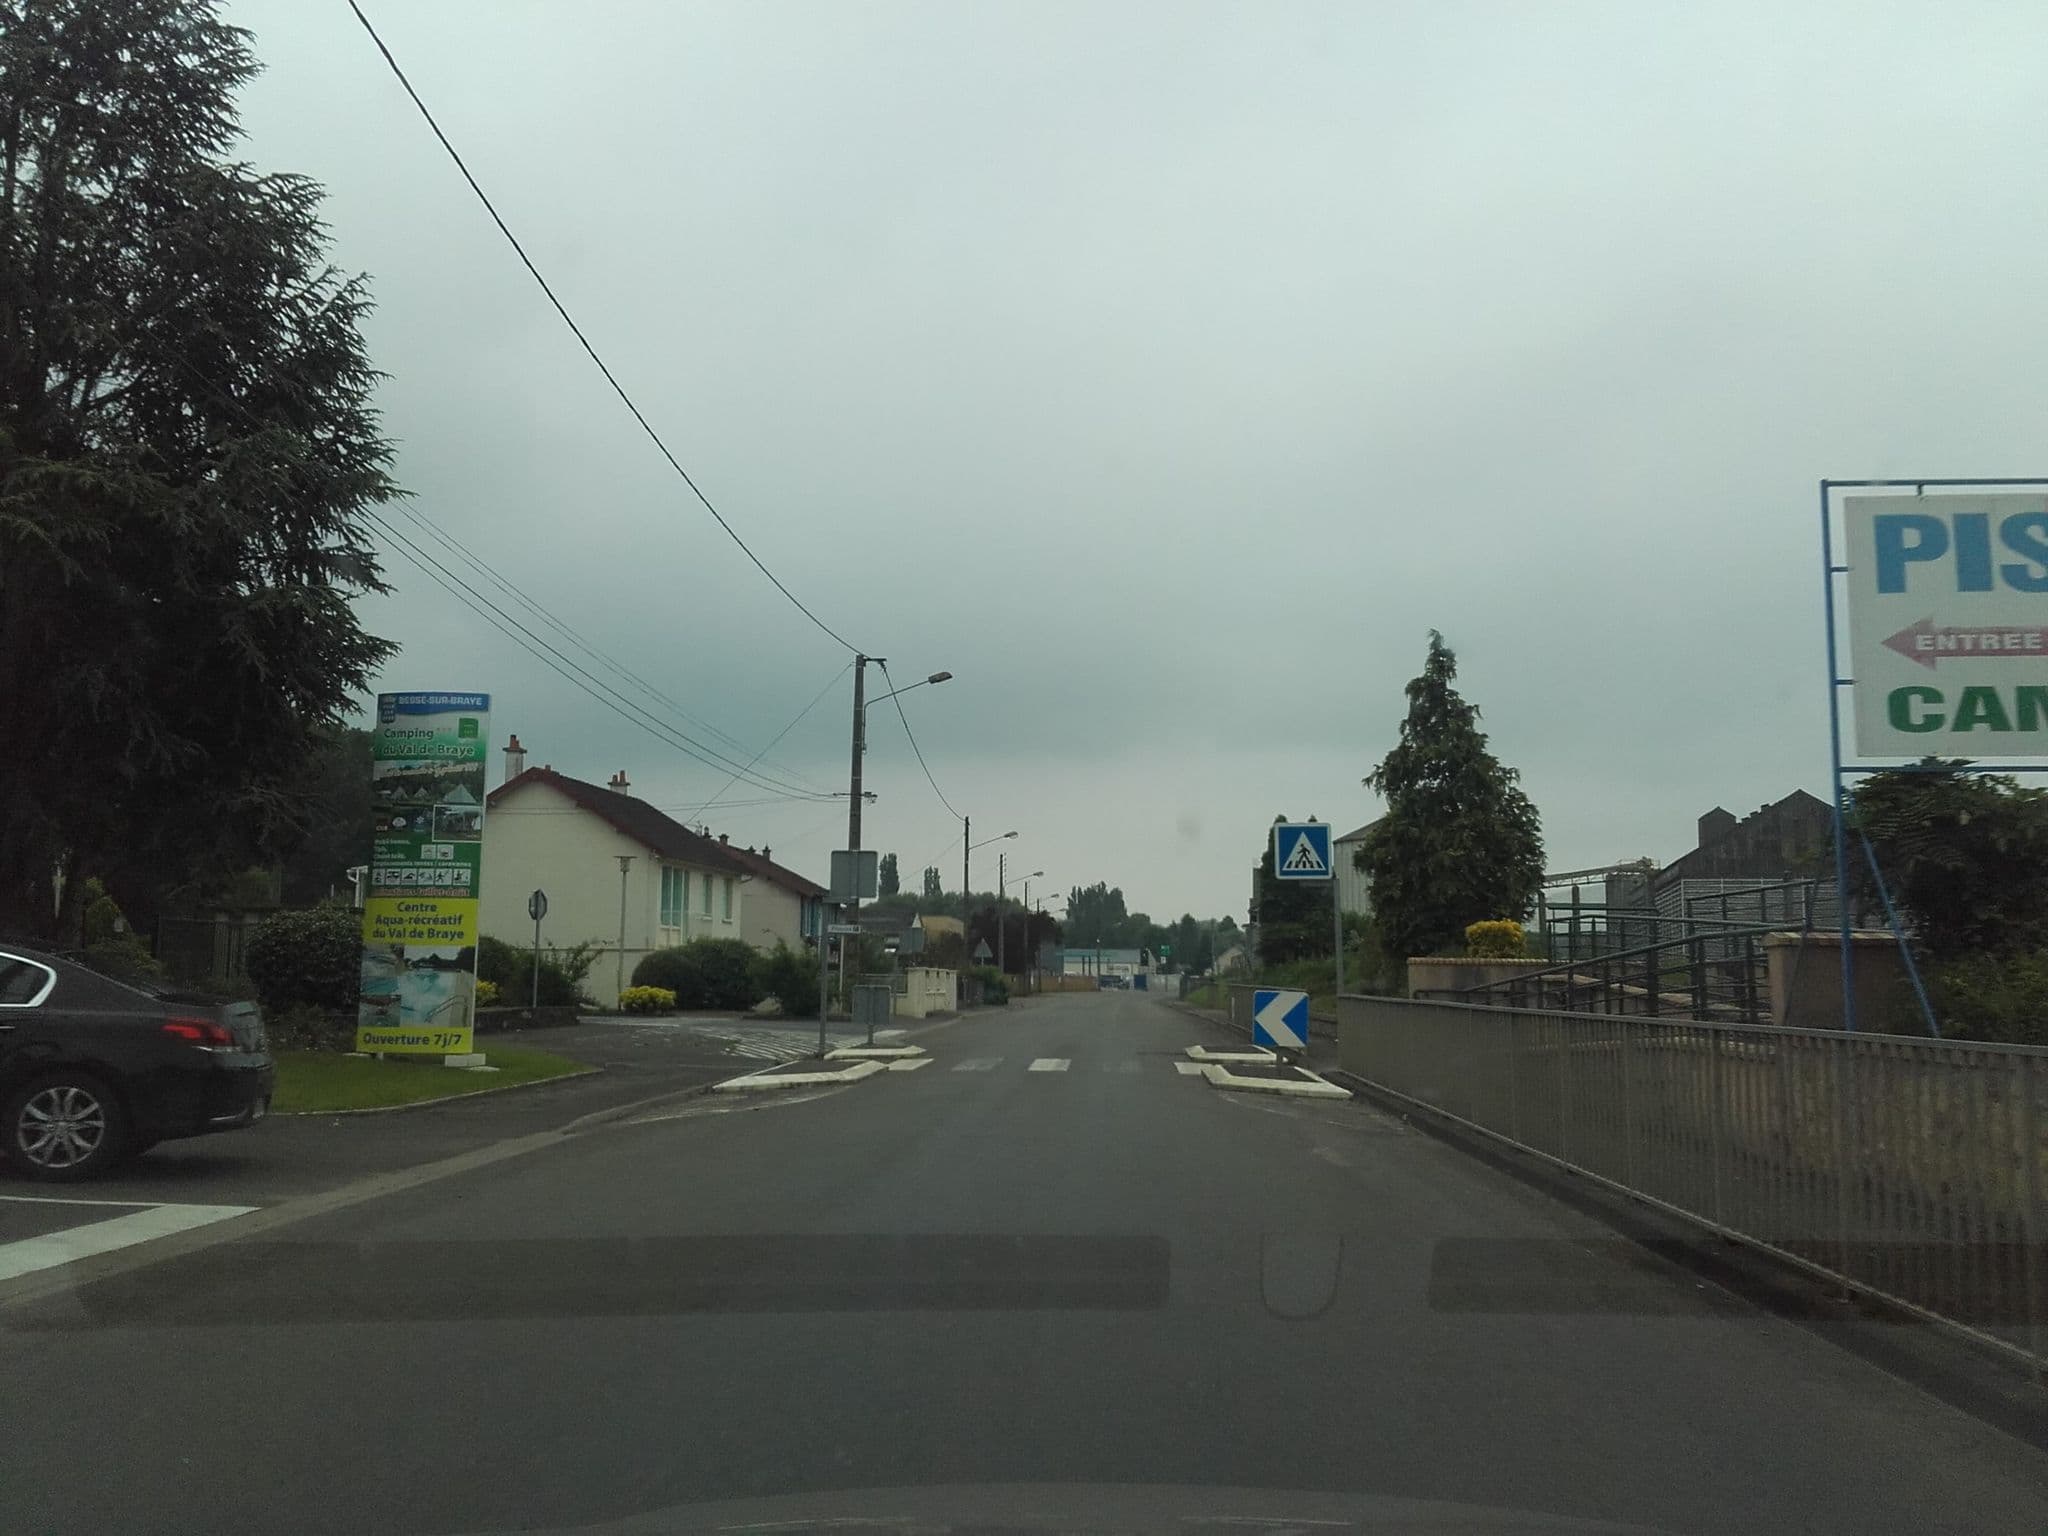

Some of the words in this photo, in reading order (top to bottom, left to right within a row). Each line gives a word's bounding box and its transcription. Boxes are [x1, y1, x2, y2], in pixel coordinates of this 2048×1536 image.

[1873, 511, 2048, 595] PIS
[1915, 633, 2042, 651] ENTREE
[383, 727, 434, 740] Camping
[398, 744, 417, 755] Val
[419, 744, 434, 755] de
[437, 744, 475, 757] Braye
[397, 901, 438, 912] Centre
[372, 928, 386, 939] du
[388, 928, 407, 939] Val
[409, 928, 425, 939] de
[427, 928, 465, 941] Braye
[363, 1032, 430, 1046] Ouverture
[433, 1034, 462, 1049] 7j/7
